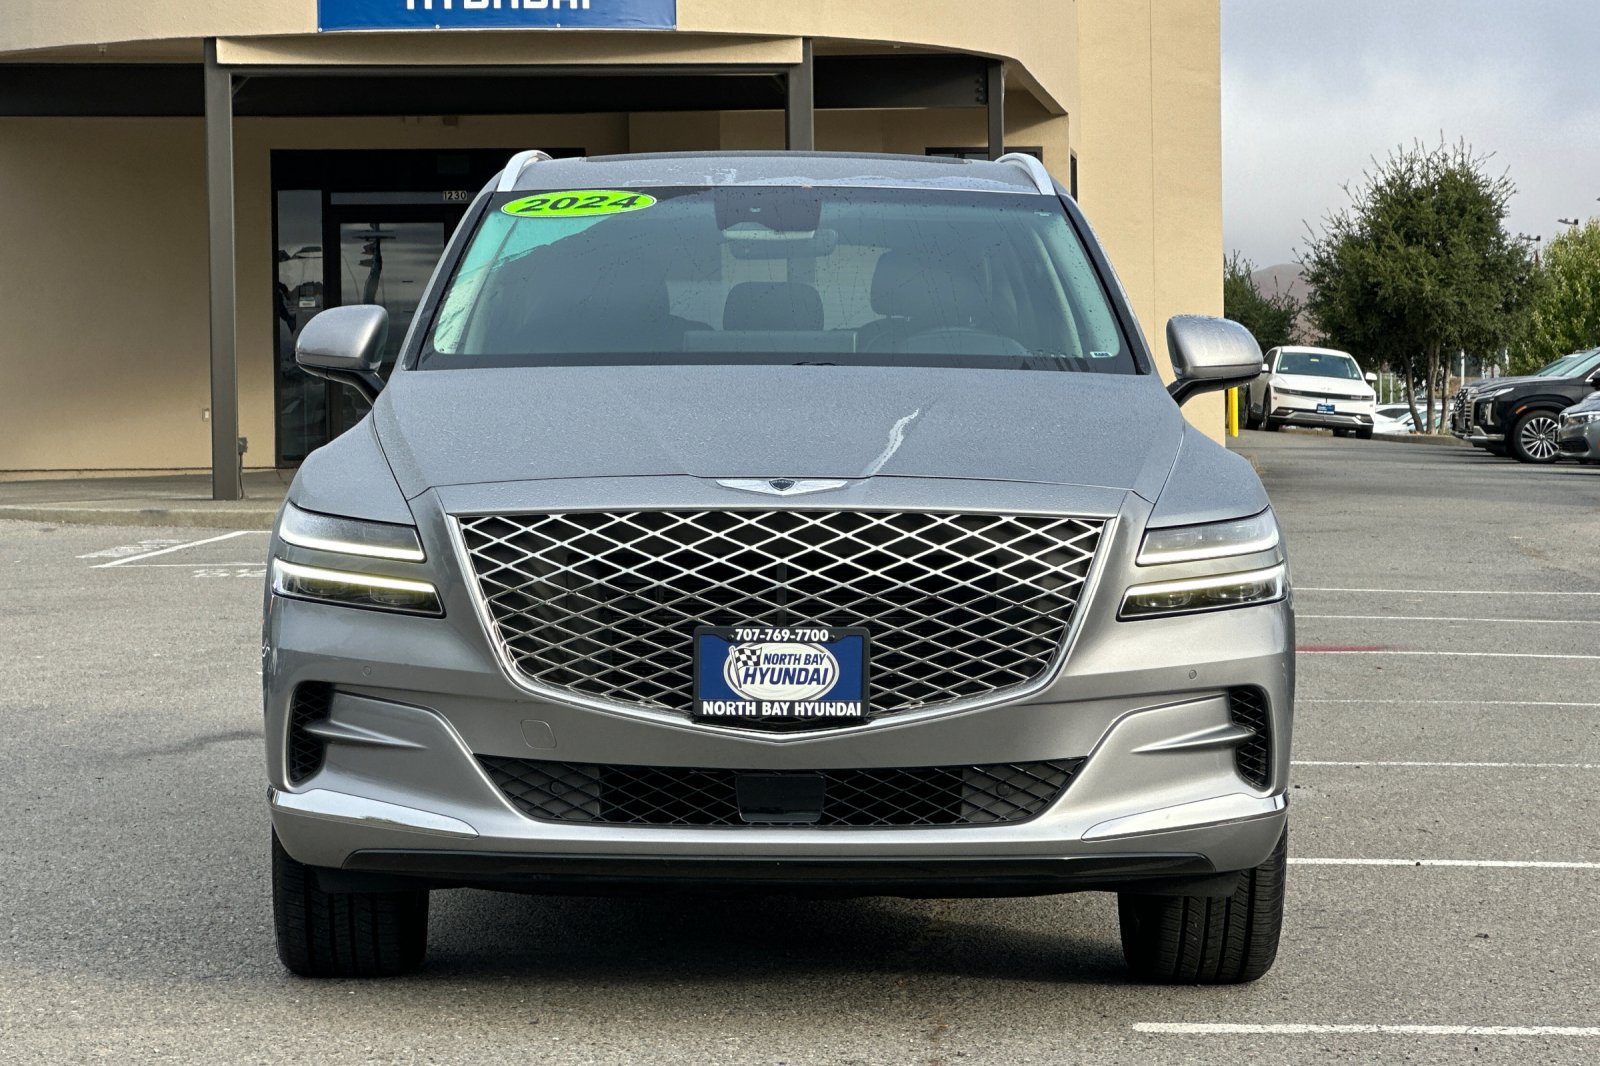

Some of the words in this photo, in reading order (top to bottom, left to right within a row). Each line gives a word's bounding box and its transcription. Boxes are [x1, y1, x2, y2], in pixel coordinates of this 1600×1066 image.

[444, 191, 467, 200] 1230
[517, 194, 641, 213] 2024
[735, 629, 829, 642] 707-769-7700
[762, 653, 801, 666] NORTH
[803, 653, 826, 666] BAY
[742, 667, 829, 686] HYUNDAI
[702, 701, 757, 716] NORTH
[762, 701, 790, 716] BAY
[794, 702, 862, 717] HYUNDAI
